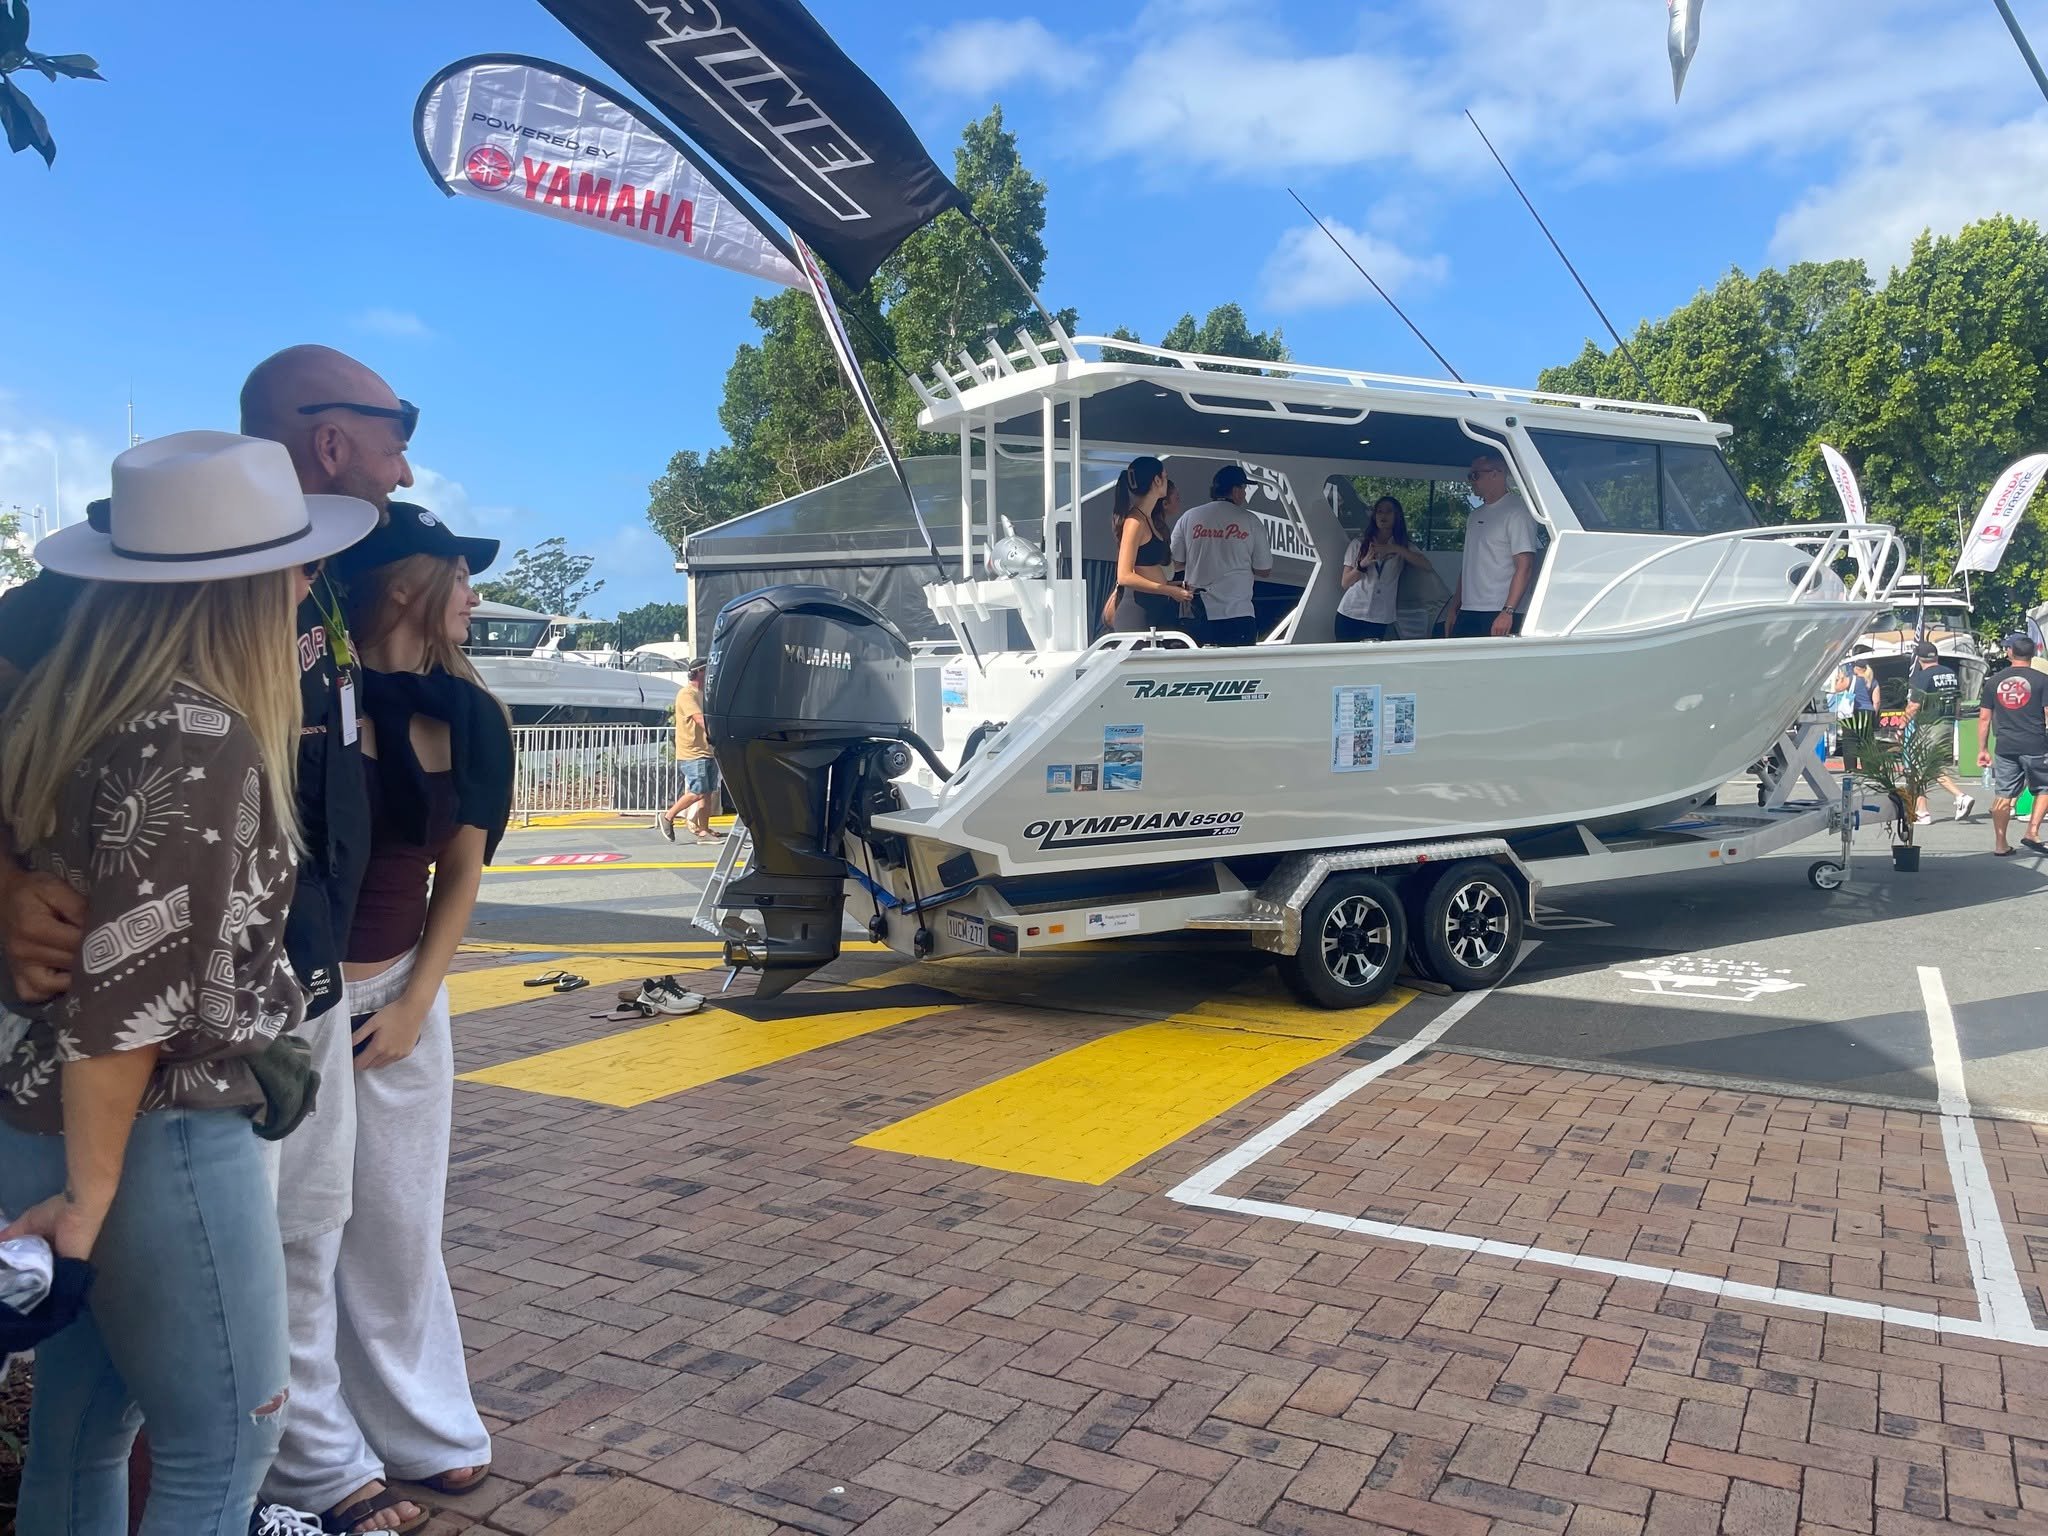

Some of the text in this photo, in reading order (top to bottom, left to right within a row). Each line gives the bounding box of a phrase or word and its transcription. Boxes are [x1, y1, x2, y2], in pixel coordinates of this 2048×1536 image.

[471, 112, 617, 159] POWERED BY
[522, 156, 695, 243] YAMAHA
[1992, 471, 2023, 517] HONDA
[1193, 523, 1249, 540] Barra Pro
[784, 644, 852, 671] YAMAHA
[1932, 673, 1955, 681] FIRST
[1125, 679, 1270, 702] RAZERLINE
[1022, 810, 1244, 850] OLYMPIAN 8500
[1212, 827, 1236, 836] 7.6M
[1639, 958, 1793, 975] PARKING
[1675, 956, 1760, 966] ONLY
